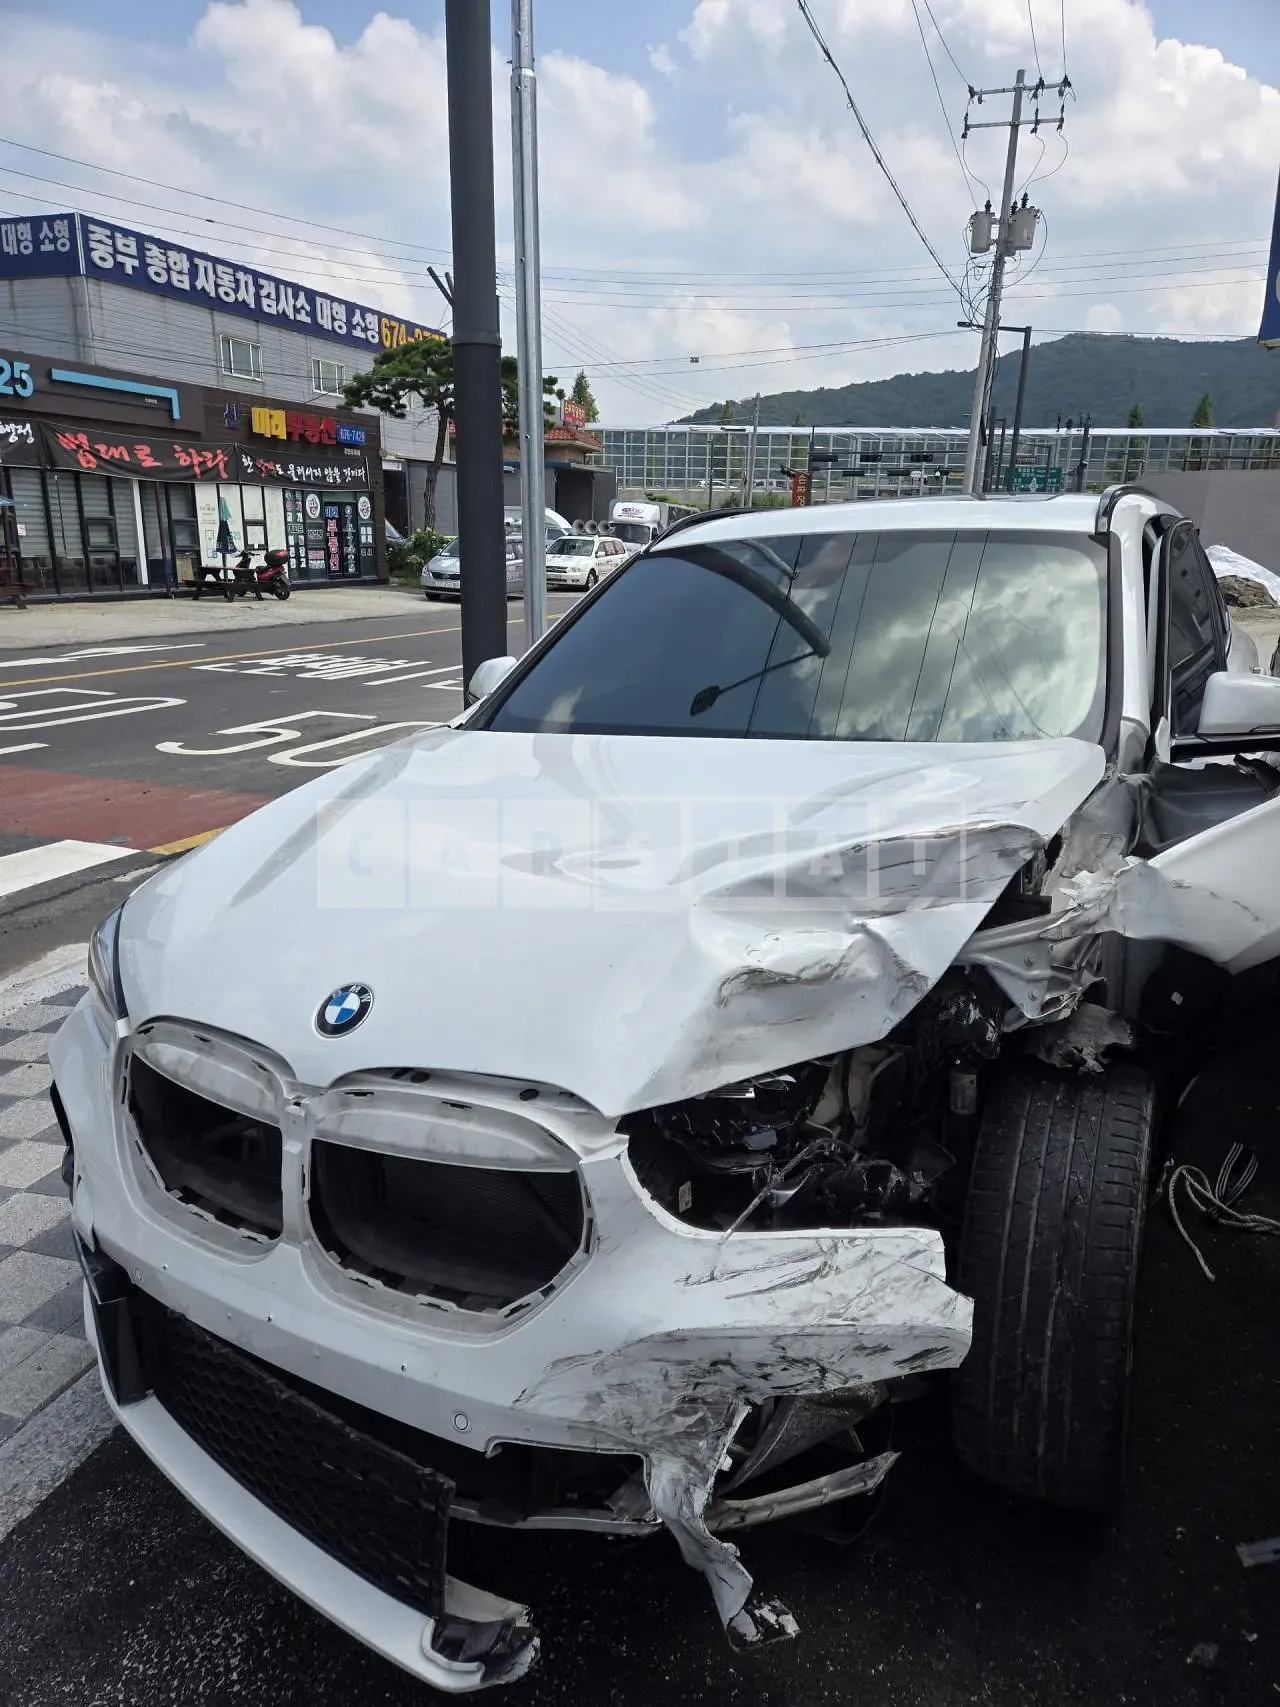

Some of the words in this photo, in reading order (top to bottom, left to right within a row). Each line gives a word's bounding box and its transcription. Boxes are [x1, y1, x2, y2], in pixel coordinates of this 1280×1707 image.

[1, 221, 33, 255] 대형
[39, 219, 71, 253] 소형
[87, 223, 139, 275] 중부
[144, 241, 191, 291] 종합
[193, 257, 255, 309] 자동차
[258, 279, 312, 324] 검사소
[315, 296, 347, 335] 대형
[351, 308, 379, 344] 소형
